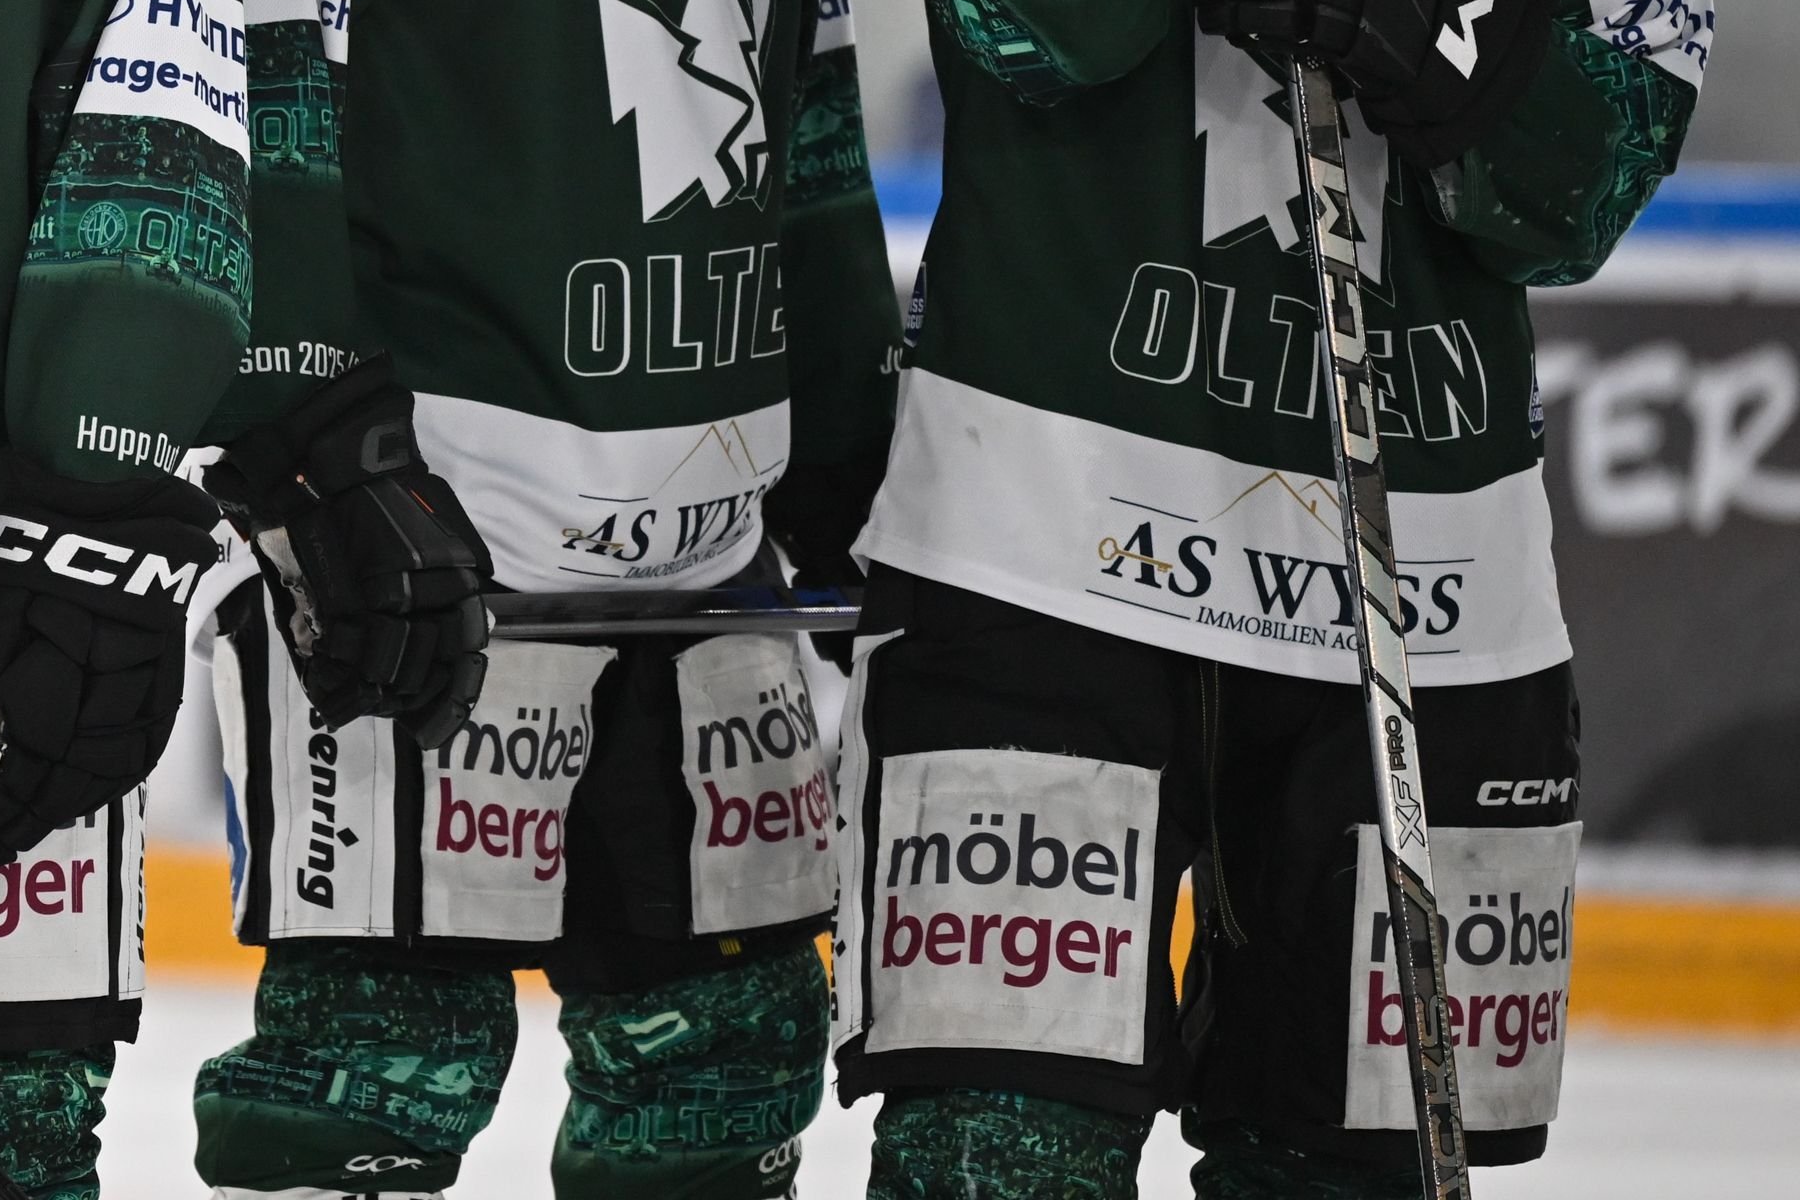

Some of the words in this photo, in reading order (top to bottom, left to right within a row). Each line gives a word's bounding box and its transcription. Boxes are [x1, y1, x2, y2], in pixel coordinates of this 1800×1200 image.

[76, 415, 151, 466] Hopp
[562, 509, 657, 562] AS
[1101, 521, 1218, 598] AS
[1196, 607, 1327, 648] IMMOBILIEN
[1386, 714, 1408, 771] PRO
[1476, 776, 1579, 807] CCM
[886, 812, 1140, 902] möbel
[881, 895, 1133, 988] berger
